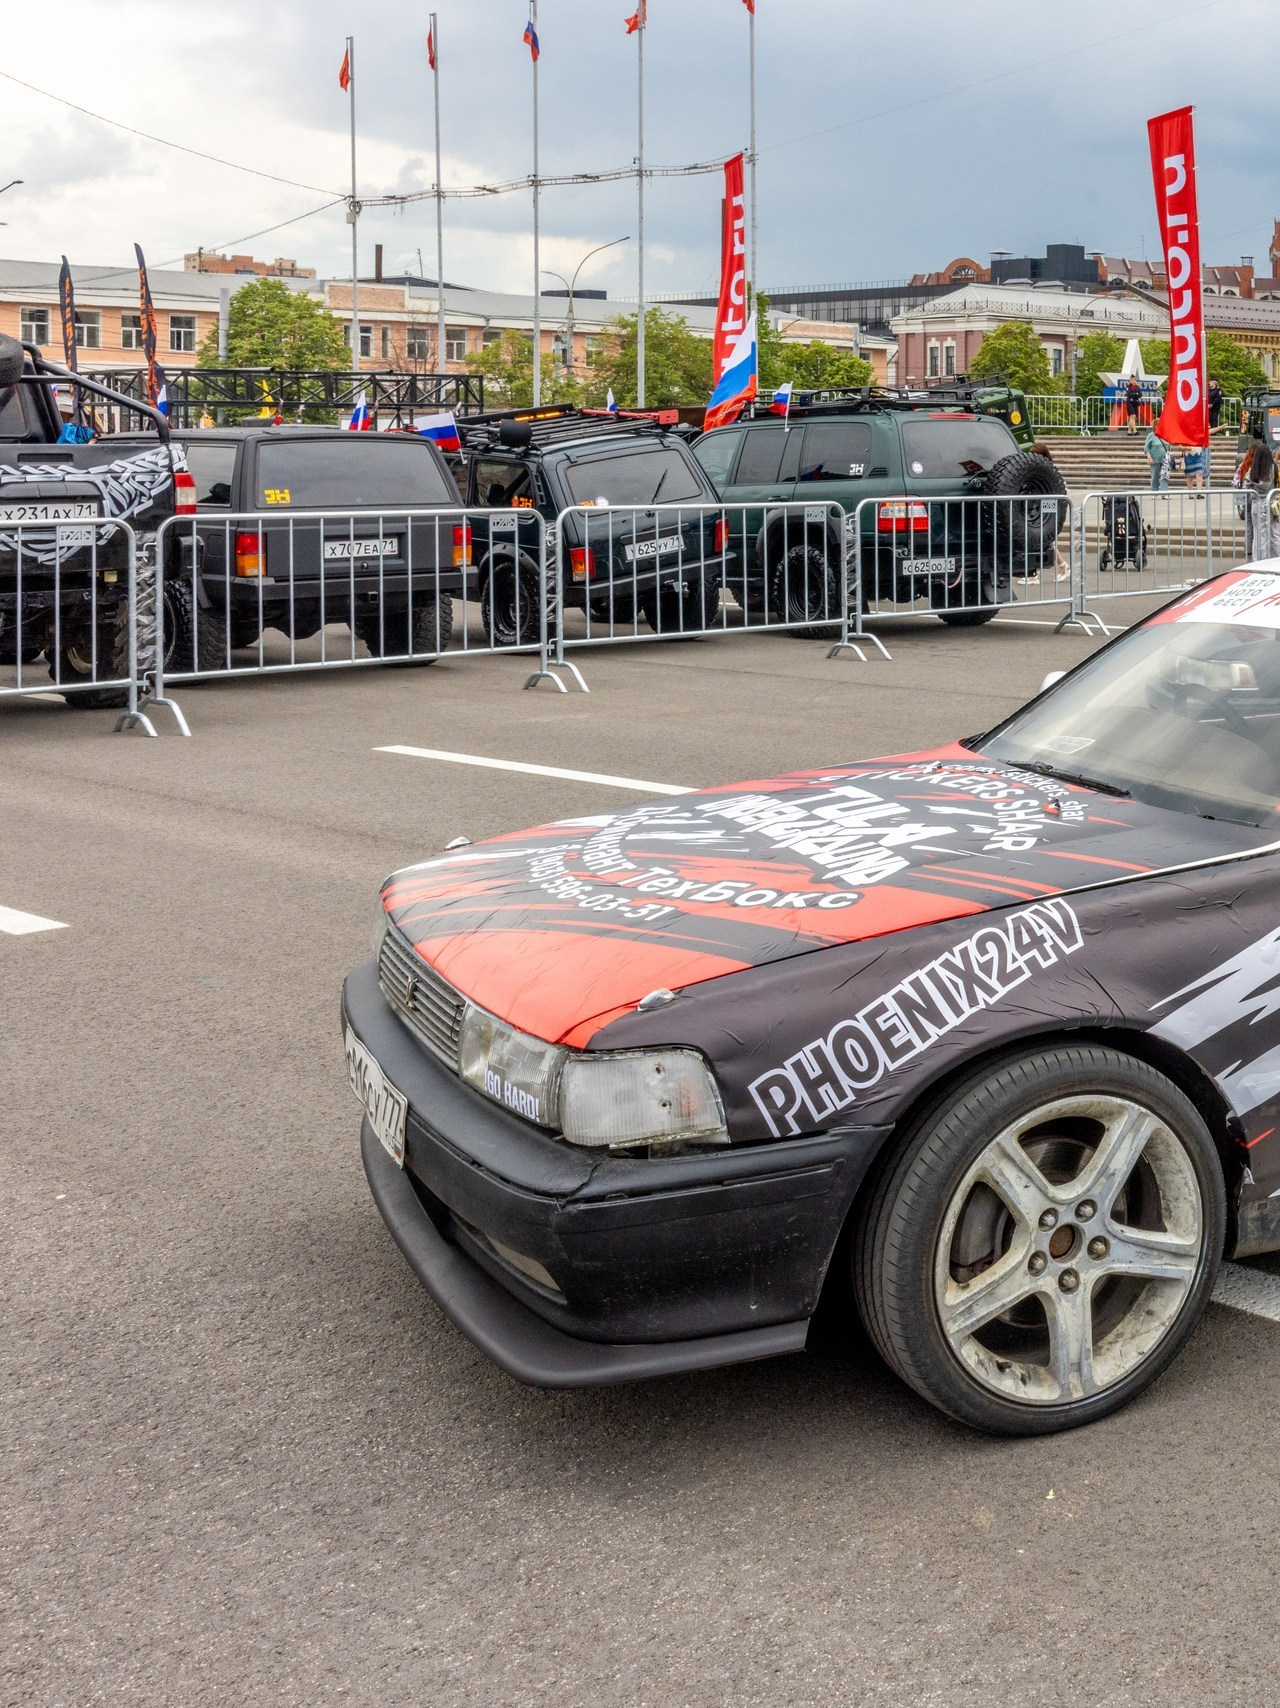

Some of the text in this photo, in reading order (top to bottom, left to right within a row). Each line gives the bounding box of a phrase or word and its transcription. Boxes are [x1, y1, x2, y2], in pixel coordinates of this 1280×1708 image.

[76, 504, 92, 516] 71
[382, 540, 394, 550] 71
[1236, 578, 1276, 588] АВТО
[1224, 588, 1263, 598] МОТО
[1212, 598, 1253, 608] ФЕСТ
[982, 799, 1043, 851] SHAR
[747, 897, 1086, 1139] PHOENIX24V
[504, 1080, 541, 1123] HARD!
[383, 1084, 402, 1137] 777
